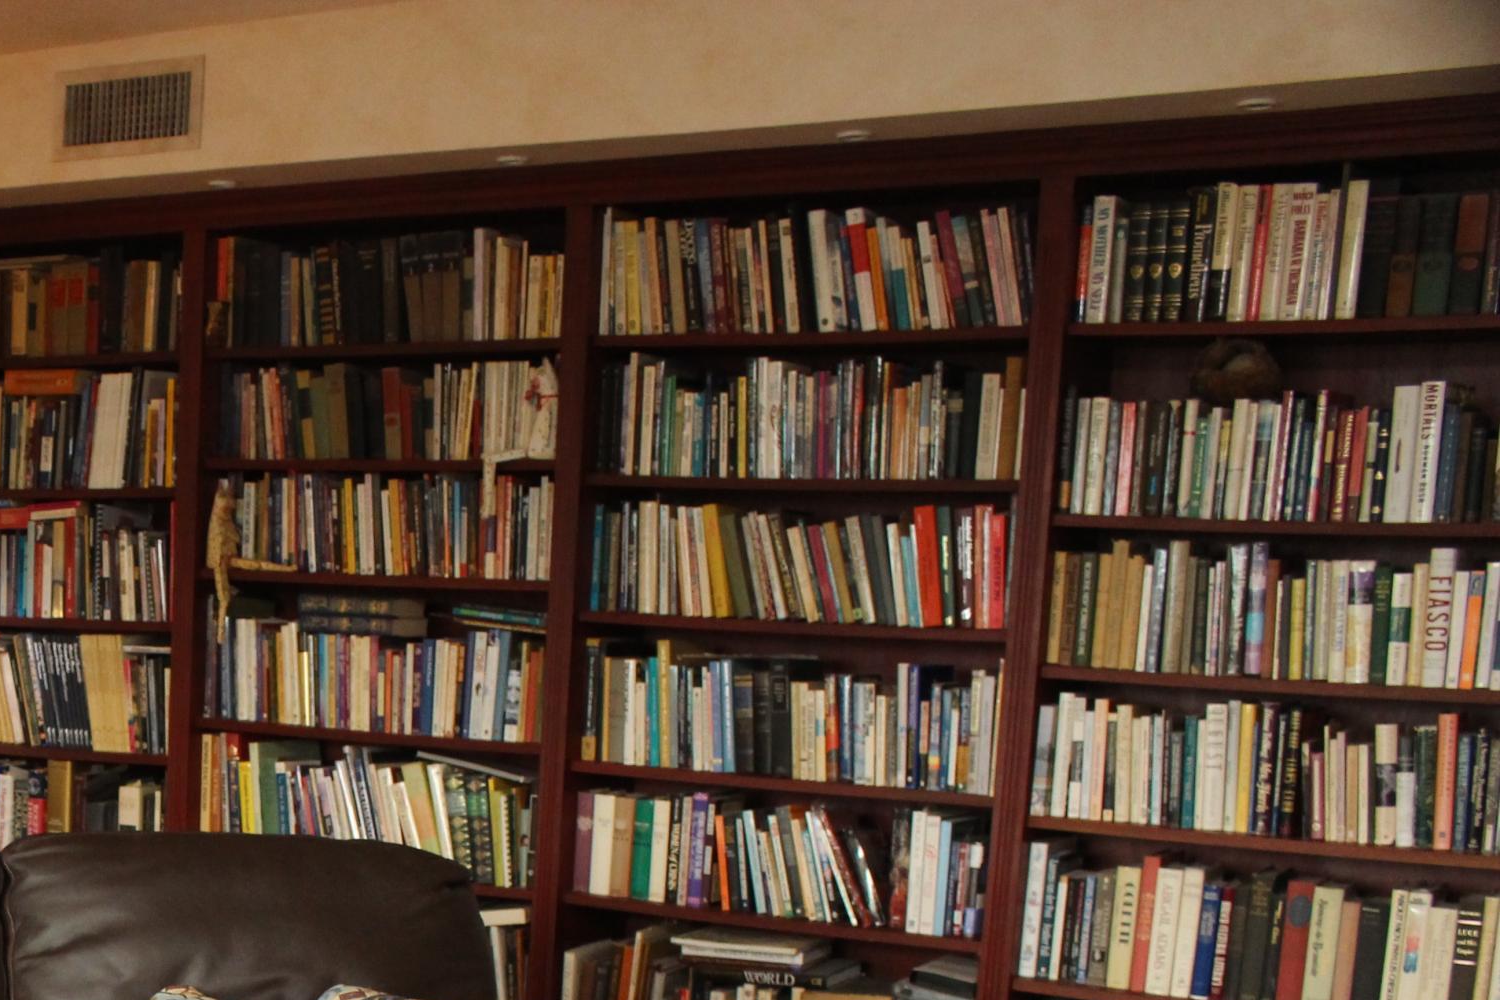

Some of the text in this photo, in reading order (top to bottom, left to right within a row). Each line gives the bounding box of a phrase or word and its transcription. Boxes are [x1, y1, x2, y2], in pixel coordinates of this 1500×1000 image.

[1098, 208, 1110, 221] MY
[1094, 225, 1109, 267] MOTHER
[1291, 220, 1307, 257] BARBARA
[1093, 272, 1105, 285] MY
[1188, 223, 1213, 299] Prometheus
[1418, 384, 1440, 504] MORTALS NORMAN RUSH
[1424, 576, 1453, 652] FIASCO
[1154, 884, 1174, 970] ABIGAIL ADAMS
[1457, 929, 1479, 937] LUCE
[743, 970, 795, 986] WORLD
